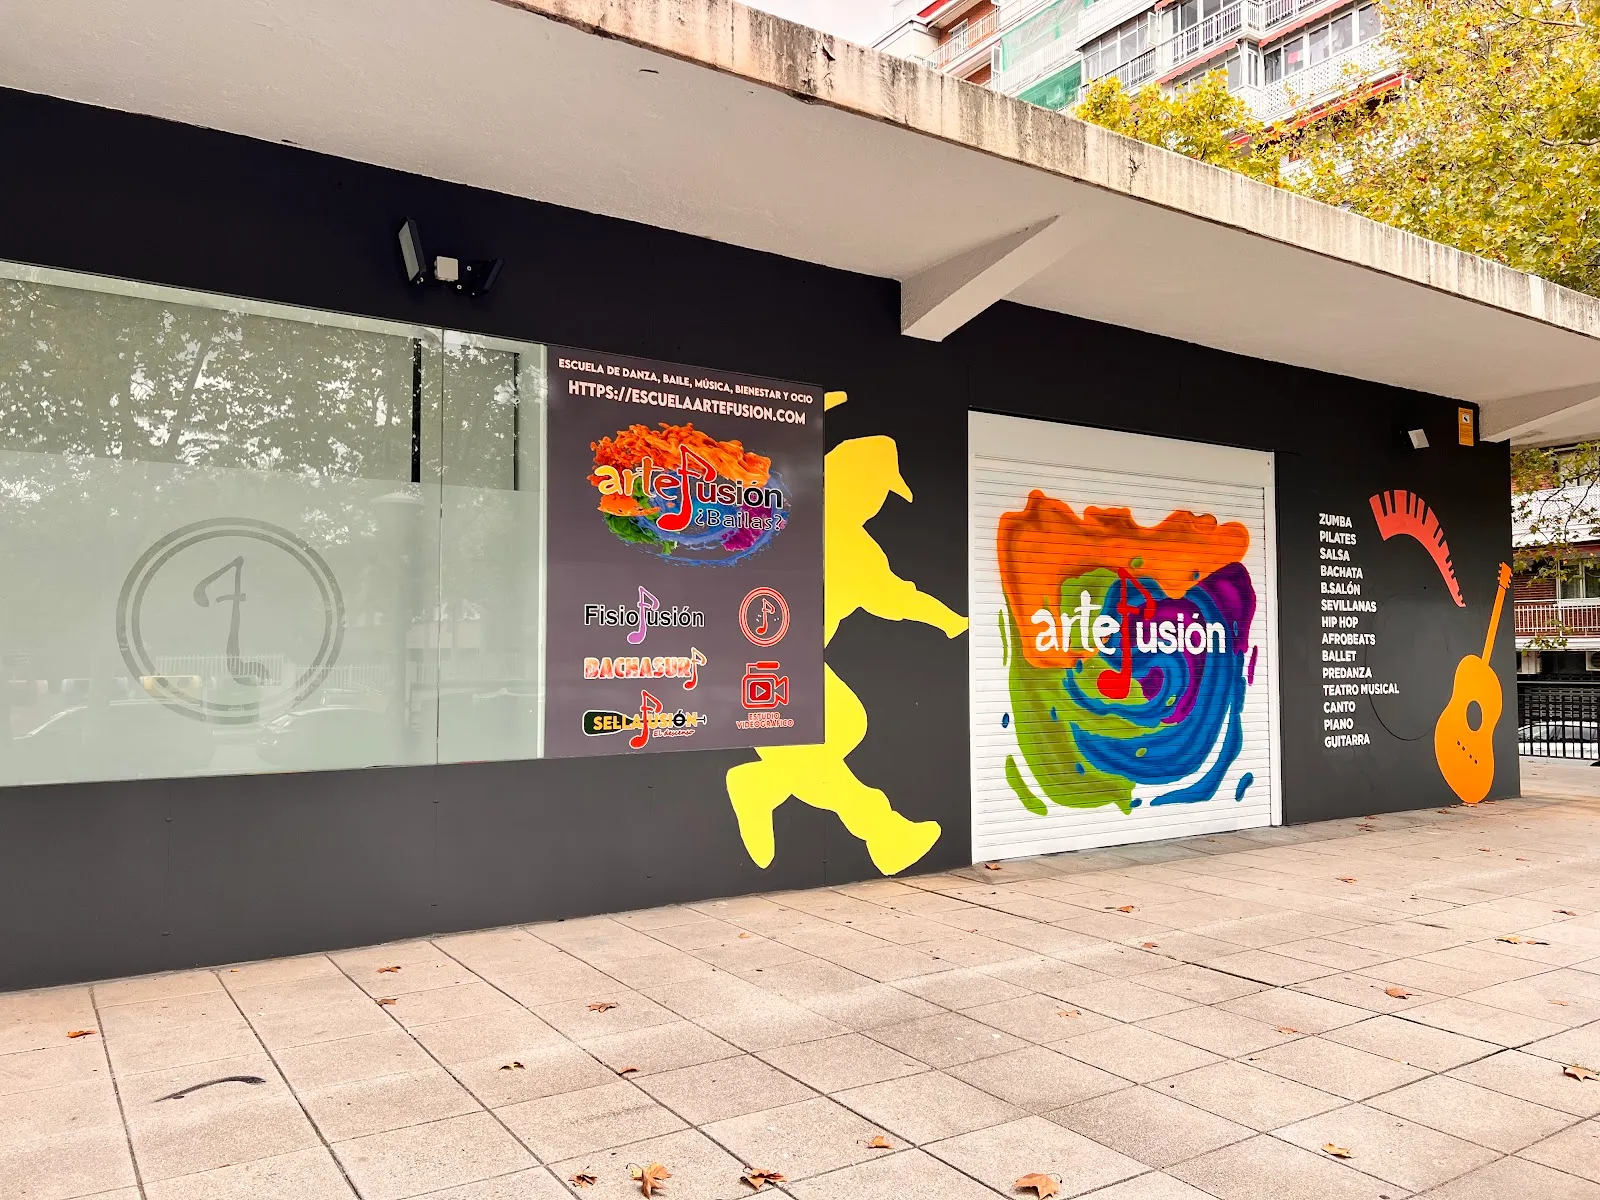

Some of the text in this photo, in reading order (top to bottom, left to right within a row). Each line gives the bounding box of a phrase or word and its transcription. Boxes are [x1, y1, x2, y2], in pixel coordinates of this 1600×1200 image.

[558, 358, 814, 404] ESCUELA DE DANZA, BAILE, MÚSICA, BIENESTAR Y OCIO
[568, 379, 806, 425] HTTPS://ESCUELAARTEFUSION.COM
[694, 508, 783, 530] ¿Bailas?
[1319, 513, 1353, 528] ZUMBA
[1320, 530, 1357, 545] PILATES
[1320, 547, 1350, 561] SALSA
[1320, 565, 1363, 579] BACHATA
[1320, 581, 1361, 595] B.SALÓN
[1321, 599, 1377, 612] SEVILLANAS
[1322, 616, 1359, 628] HIP HOP
[1322, 633, 1376, 645] AFROBEATS
[1322, 650, 1357, 662] BALLET
[1323, 667, 1372, 679] PREDANZA
[1323, 683, 1400, 696] TEATRO MUSICAL
[1324, 701, 1356, 713] CANTO
[748, 712, 781, 720] ESTUDIO
[1324, 718, 1354, 731] PIANO
[1324, 733, 1371, 748] GUITARRA
